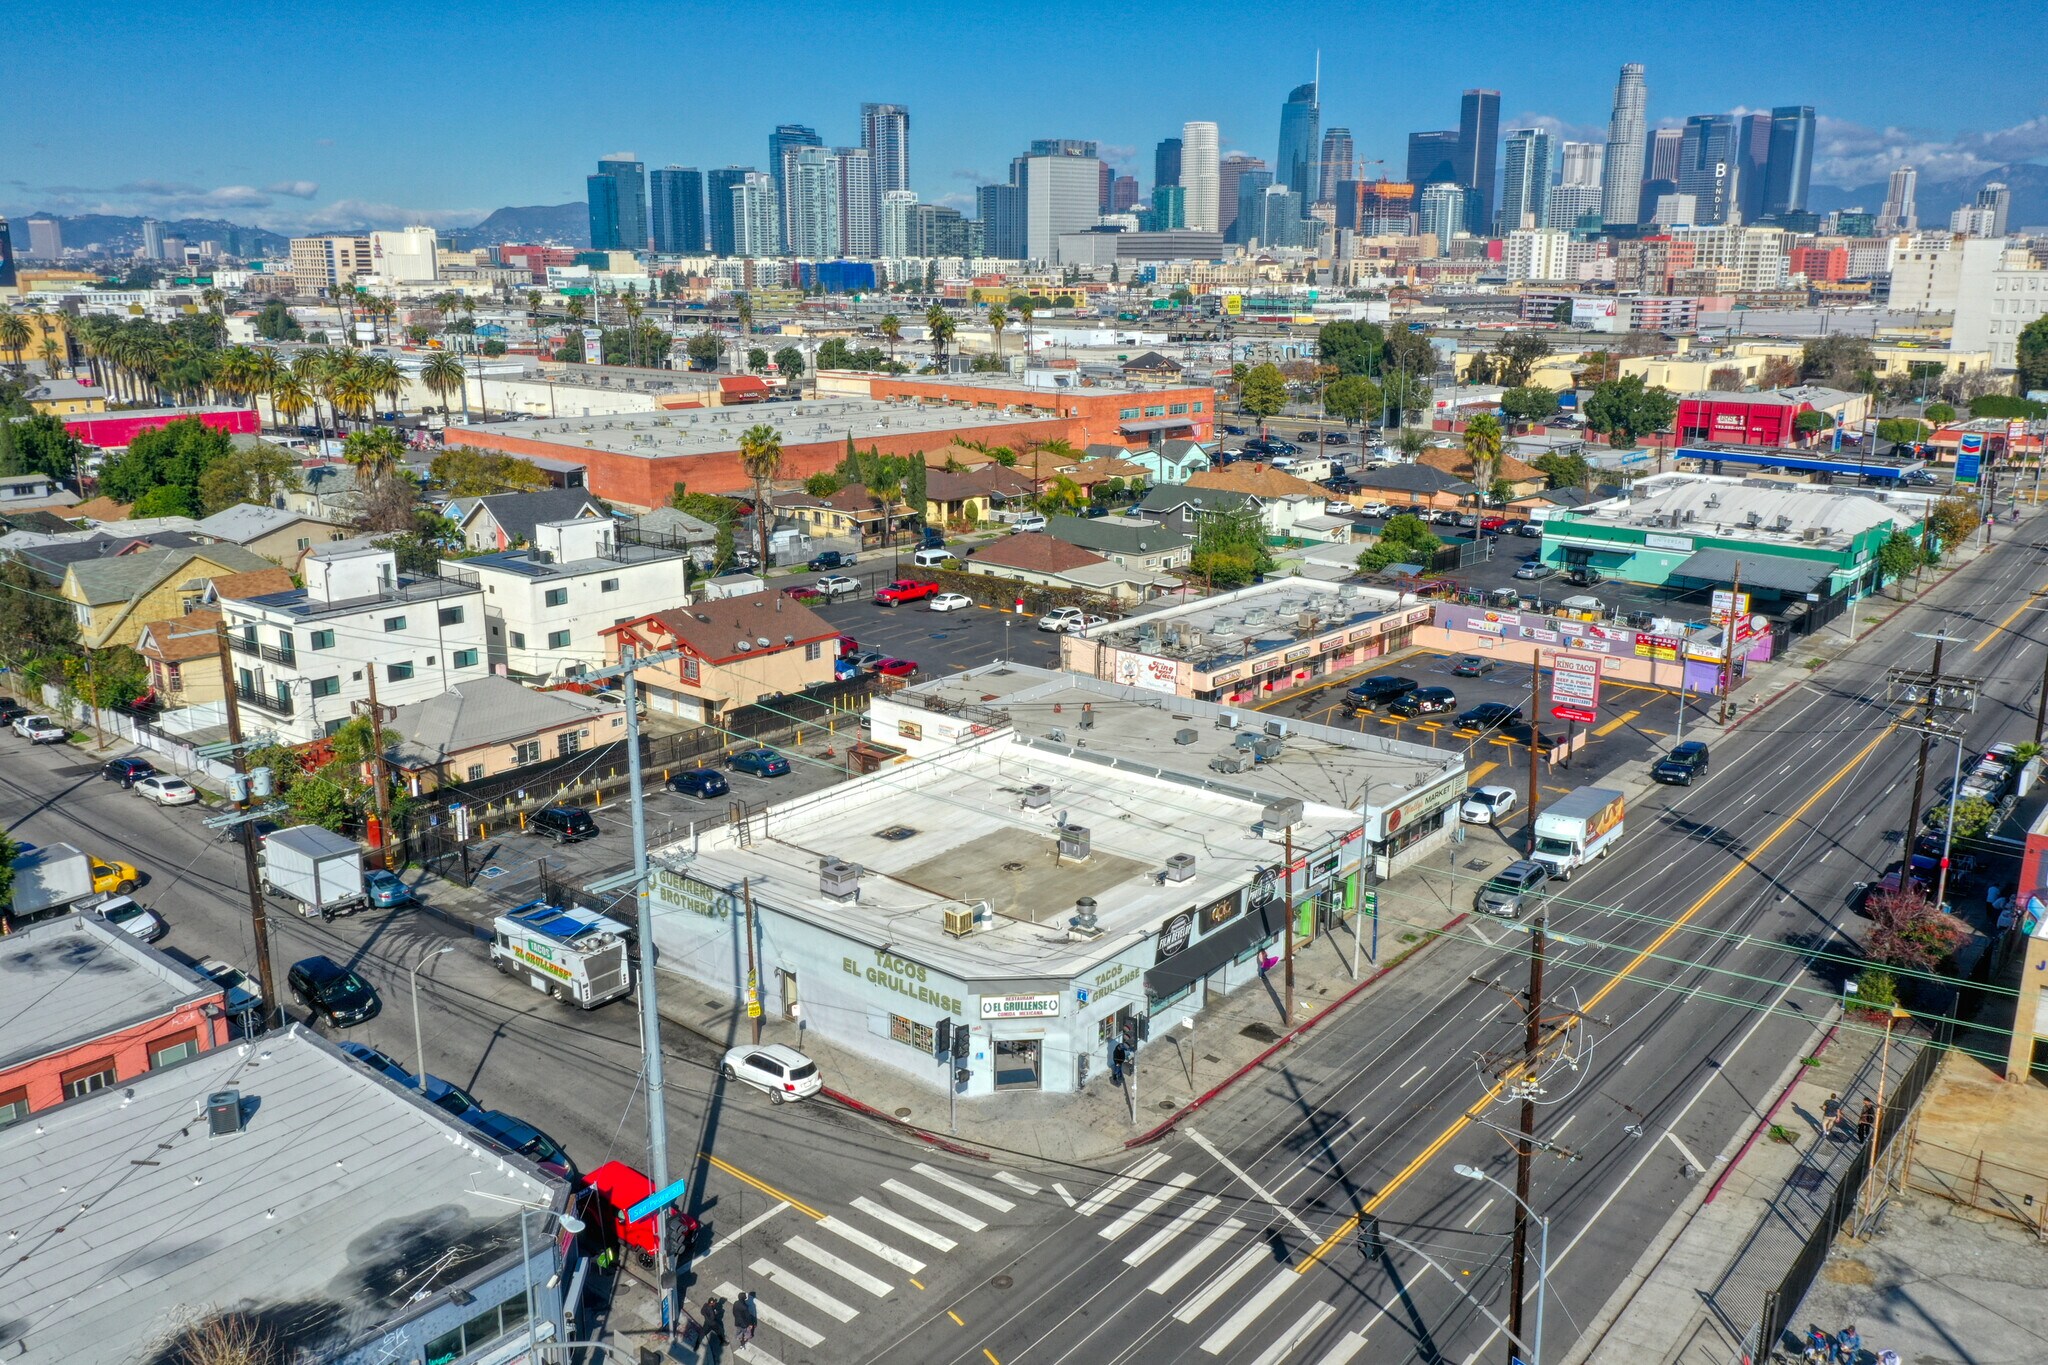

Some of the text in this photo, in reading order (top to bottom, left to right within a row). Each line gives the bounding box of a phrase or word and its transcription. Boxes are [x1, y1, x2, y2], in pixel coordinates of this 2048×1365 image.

[1713, 163, 1726, 220] BENDIX
[1148, 661, 1174, 674] King
[1154, 670, 1175, 680] Taco
[1556, 661, 1594, 672] KING TACO
[1424, 702, 1432, 711] 3
[1424, 785, 1451, 804] MARKET
[660, 870, 713, 901] GUERRERO
[660, 887, 713, 918] BROTHERS
[1159, 934, 1172, 950] FILM
[1171, 923, 1192, 943] DEVELOP
[531, 941, 550, 958] TACOS
[874, 949, 927, 982] TACOS
[1095, 963, 1123, 986] TACOS
[843, 957, 962, 1016] EL GRULLENSE
[1093, 967, 1140, 1002] GRULLENSE
[993, 1001, 1048, 1012] EL GRULLENSE
[633, 1206, 647, 1216] San
[649, 1192, 669, 1207] Pedro
